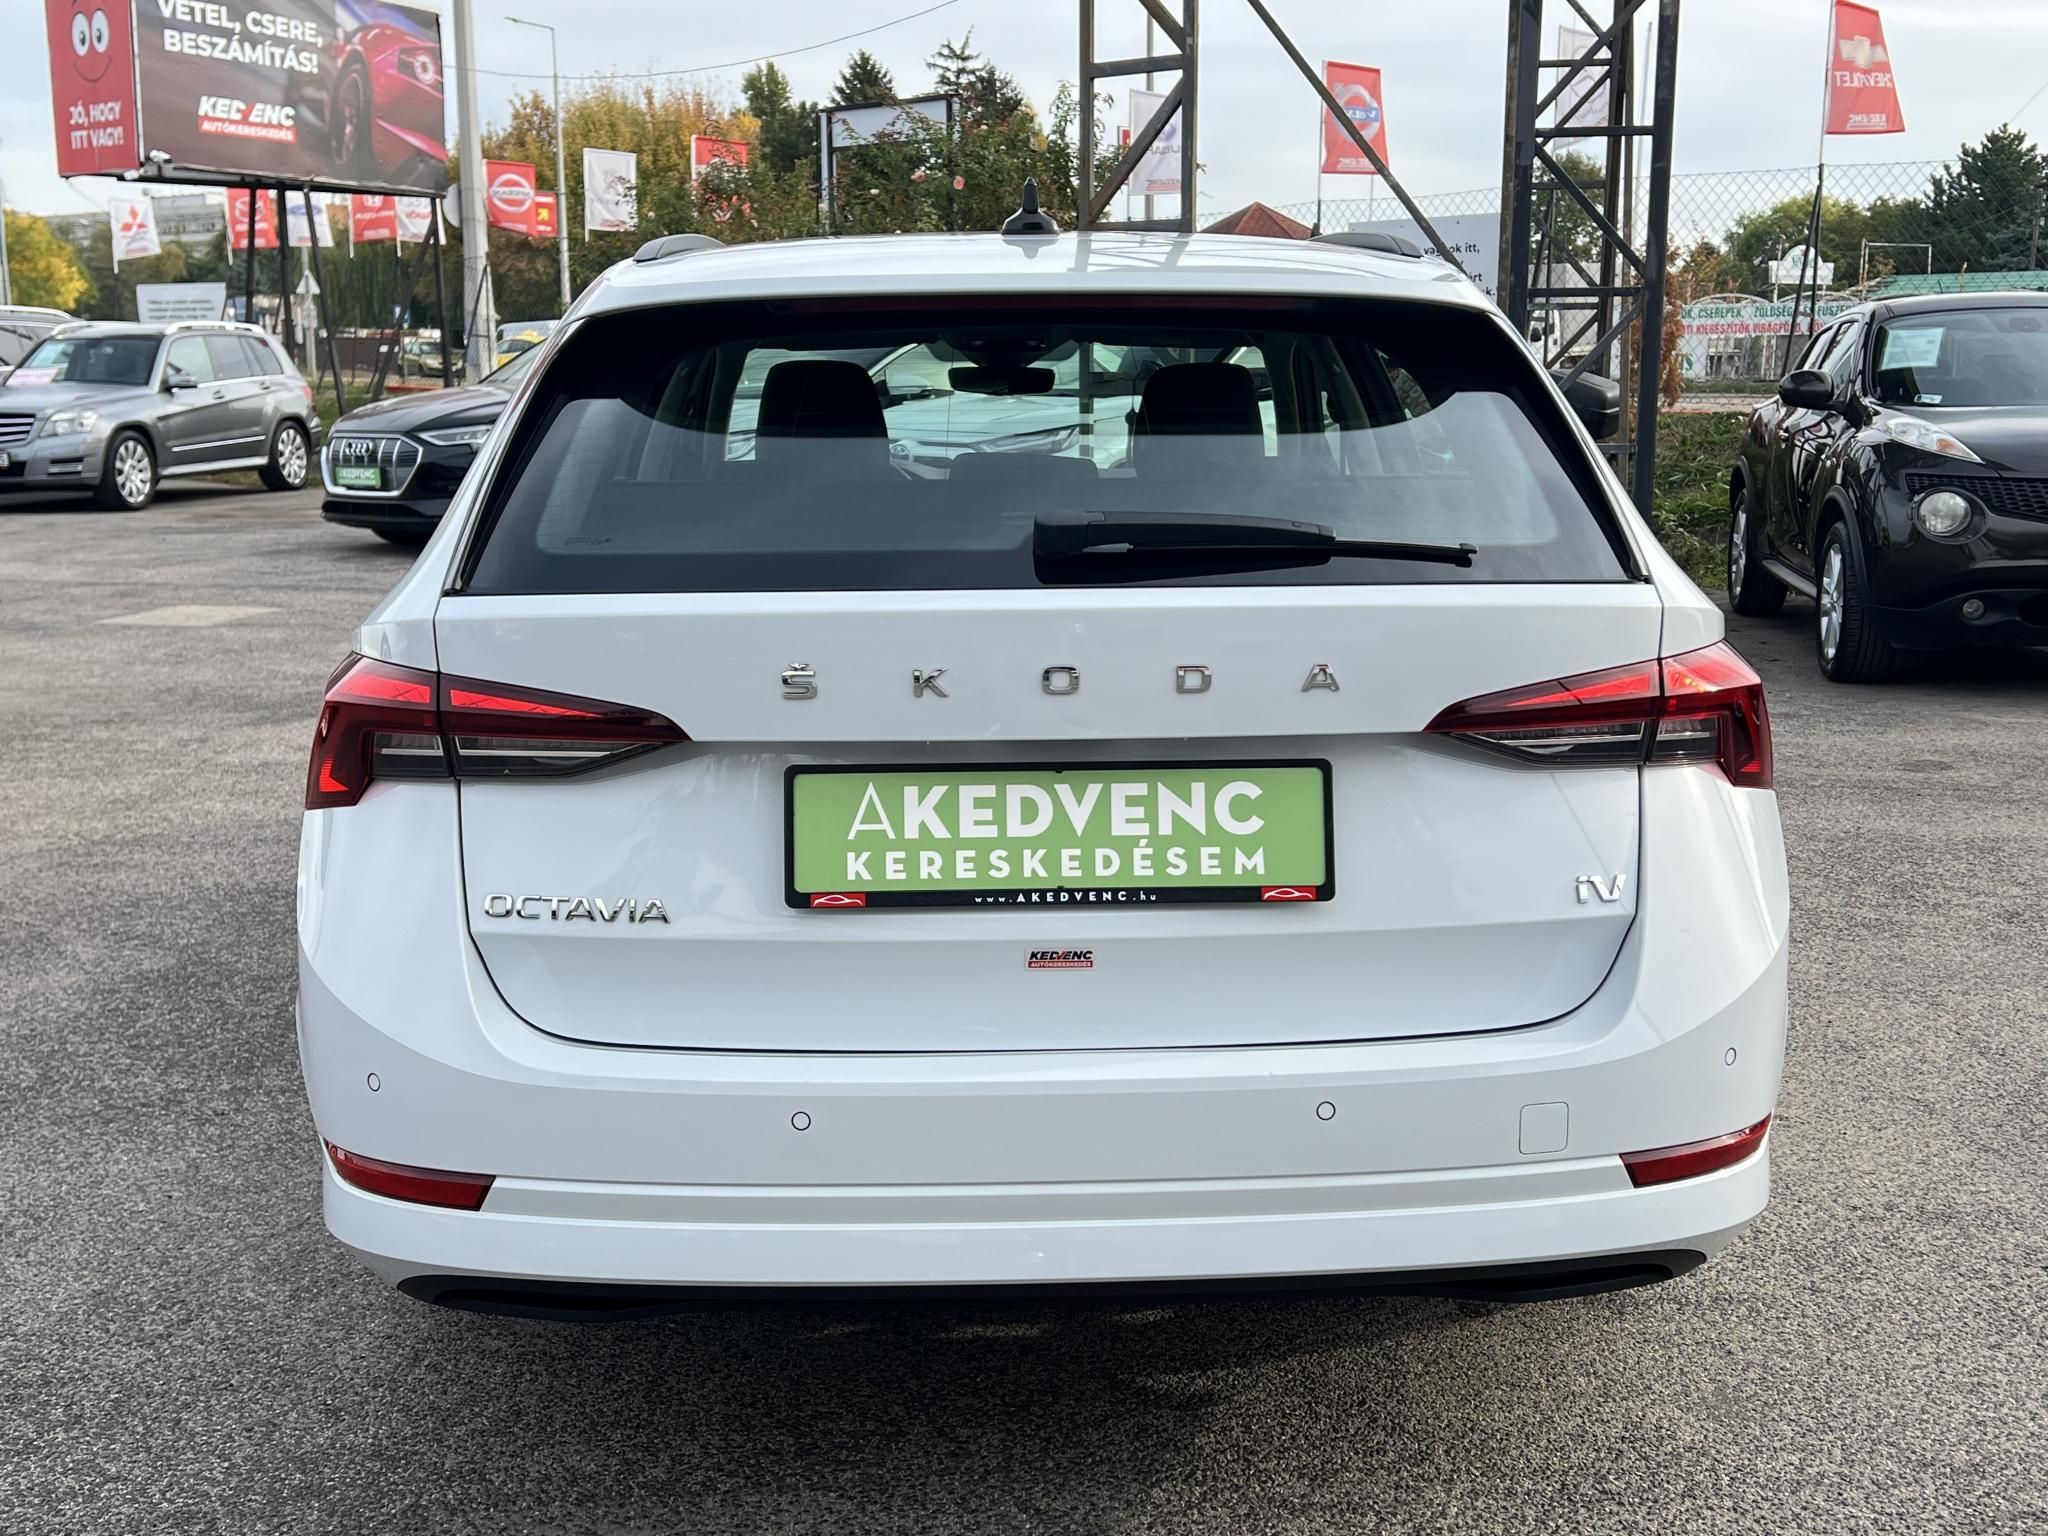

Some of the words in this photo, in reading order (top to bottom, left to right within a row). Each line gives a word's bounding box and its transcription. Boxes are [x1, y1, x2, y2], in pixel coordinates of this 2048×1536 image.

[245, 11, 324, 48] CSERE,
[163, 29, 319, 74] BESZÁMÍTÁS!
[69, 100, 89, 127] JÓ,
[89, 100, 122, 123] HOGY
[71, 130, 88, 150] ITT
[89, 126, 124, 148] VAGY!
[1465, 242, 1480, 254] itt,
[781, 662, 1340, 701] ŠKODA
[847, 838, 1266, 881] KERESKEDÉSEM
[484, 893, 671, 924] OCTAVIA
[974, 890, 1157, 903] www.AKEDVENC.hu
[1029, 950, 1093, 961] KEDVENC
